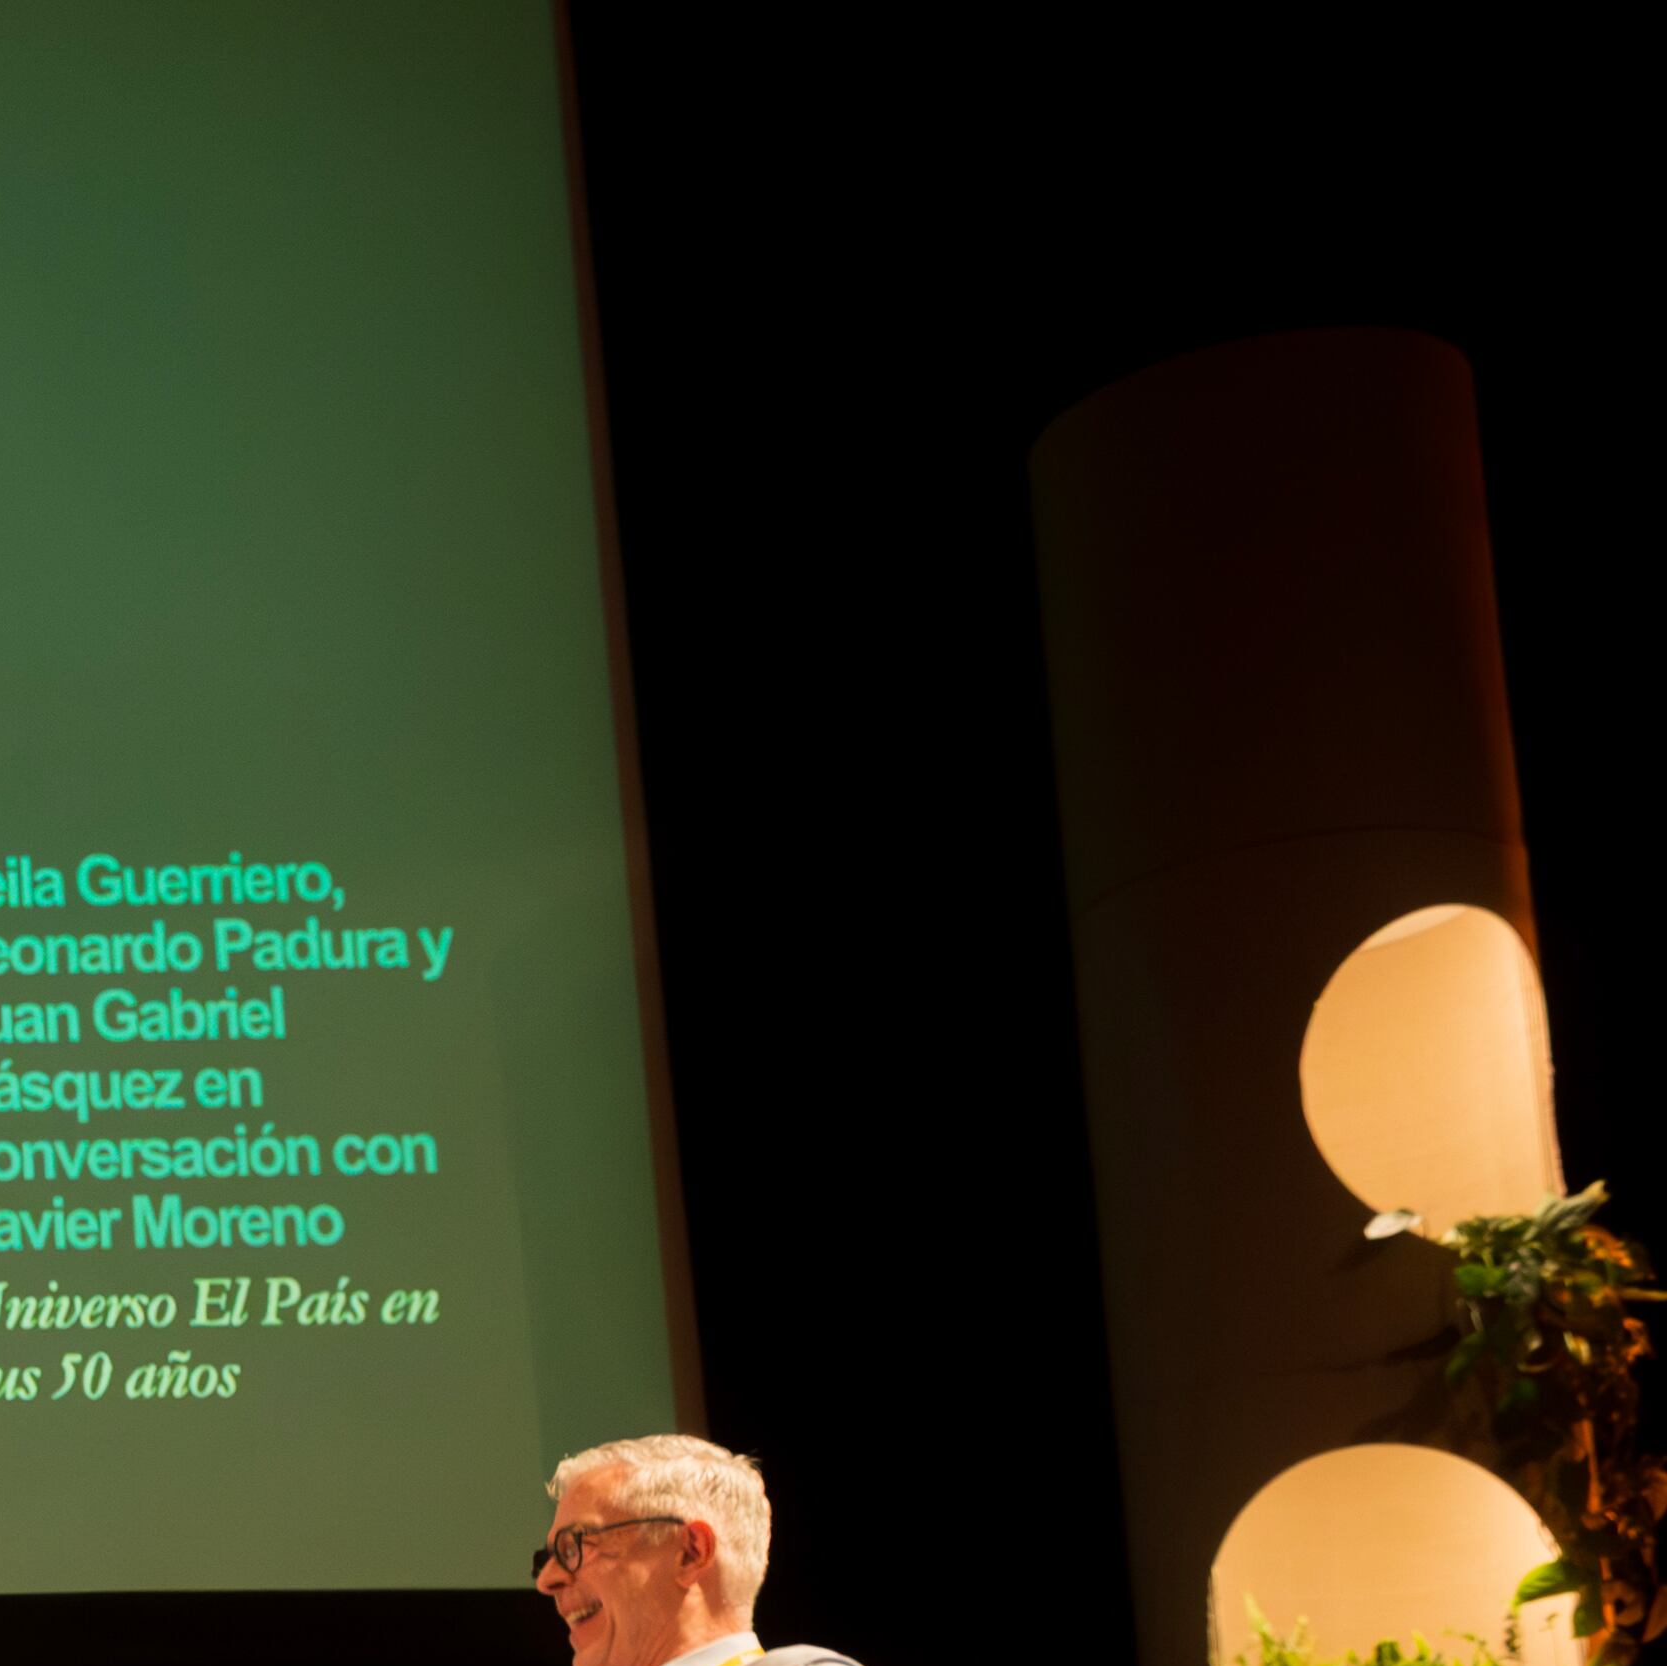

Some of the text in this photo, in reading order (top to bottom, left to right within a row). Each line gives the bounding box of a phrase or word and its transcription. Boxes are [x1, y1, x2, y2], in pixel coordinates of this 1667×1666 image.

[75, 850, 345, 911] Guerriero,
[213, 915, 410, 972] Padura
[417, 926, 454, 982] y
[92, 985, 286, 1043] Gabriel
[193, 1067, 264, 1109] en
[331, 1132, 438, 1176] con
[131, 1193, 345, 1249] Moreno
[189, 1276, 252, 1327] El
[260, 1275, 370, 1326] País
[380, 1289, 440, 1325] en
[51, 1351, 113, 1401] 50
[124, 1349, 241, 1400] años
